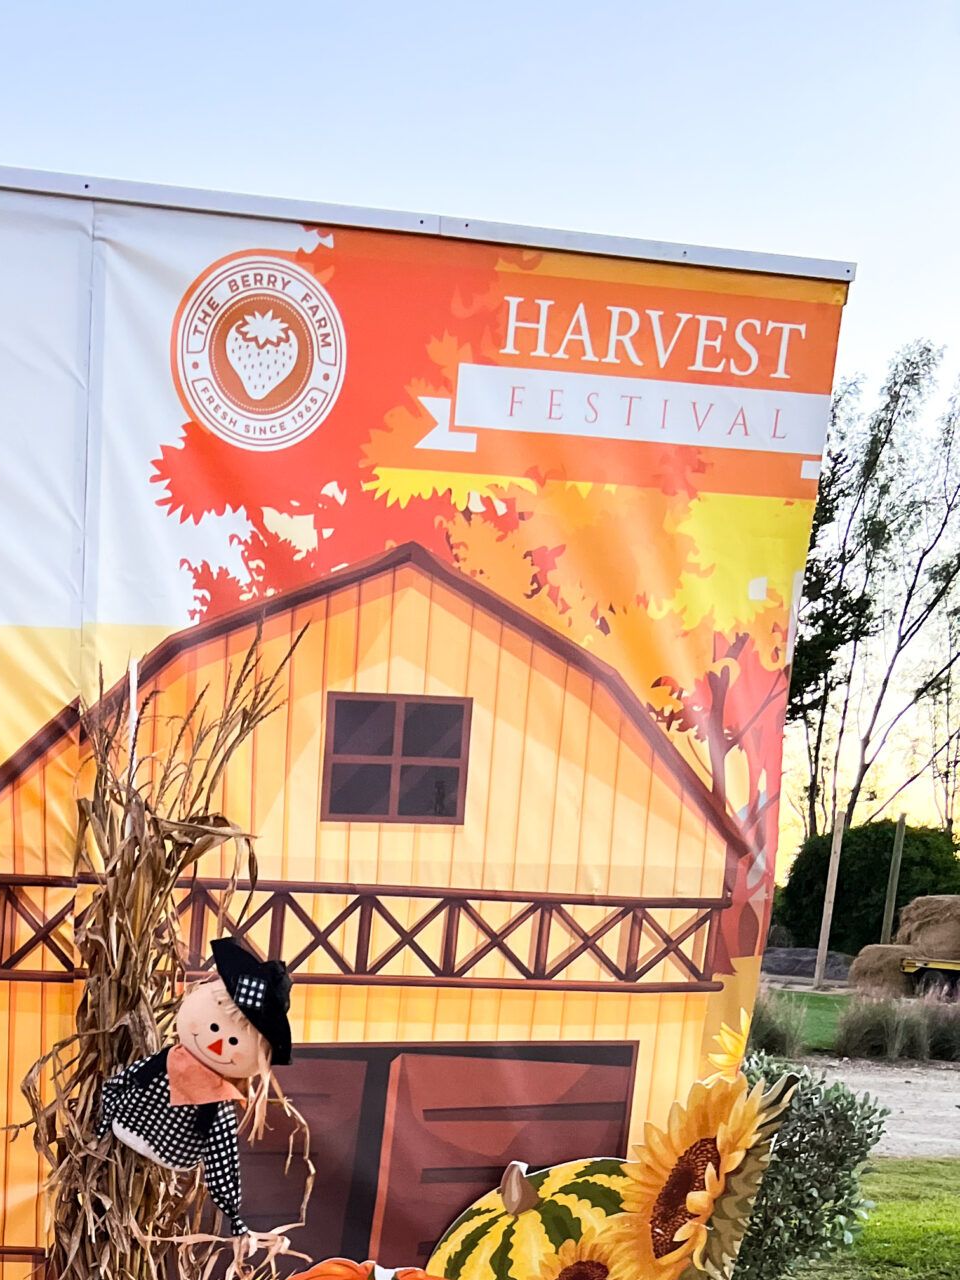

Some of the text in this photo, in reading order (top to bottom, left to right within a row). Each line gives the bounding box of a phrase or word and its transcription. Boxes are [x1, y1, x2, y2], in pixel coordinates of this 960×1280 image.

[192, 273, 332, 348] THE BERRY FARM
[499, 295, 806, 379] HARVEST
[200, 387, 318, 435] FRESH SINCE 1965
[507, 386, 788, 440] FESTIVAL
